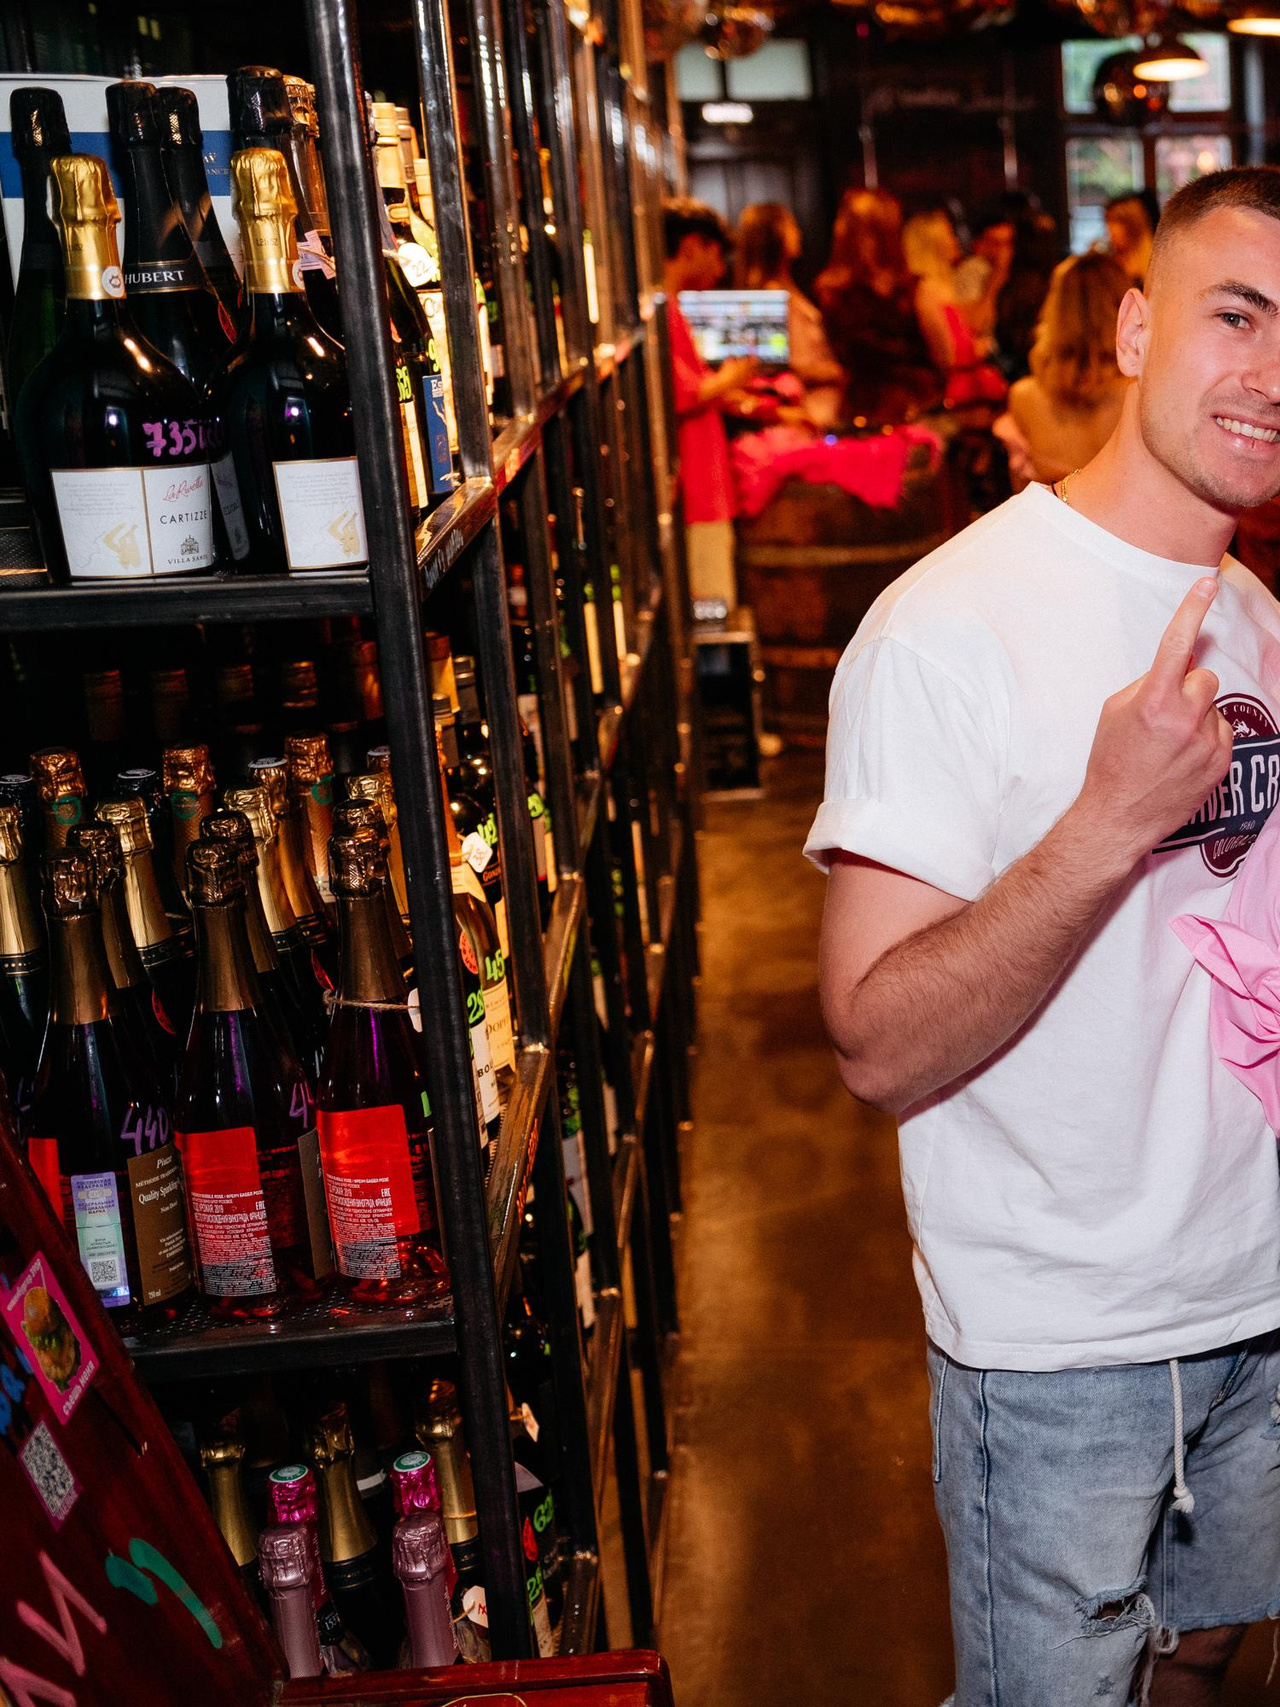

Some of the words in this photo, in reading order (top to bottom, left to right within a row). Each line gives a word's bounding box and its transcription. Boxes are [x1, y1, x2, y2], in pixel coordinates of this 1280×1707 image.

[159, 509, 208, 525] CARTIZZE
[167, 556, 191, 565] VILLA
[120, 1104, 169, 1156] 440
[138, 1186, 160, 1205] Quality
